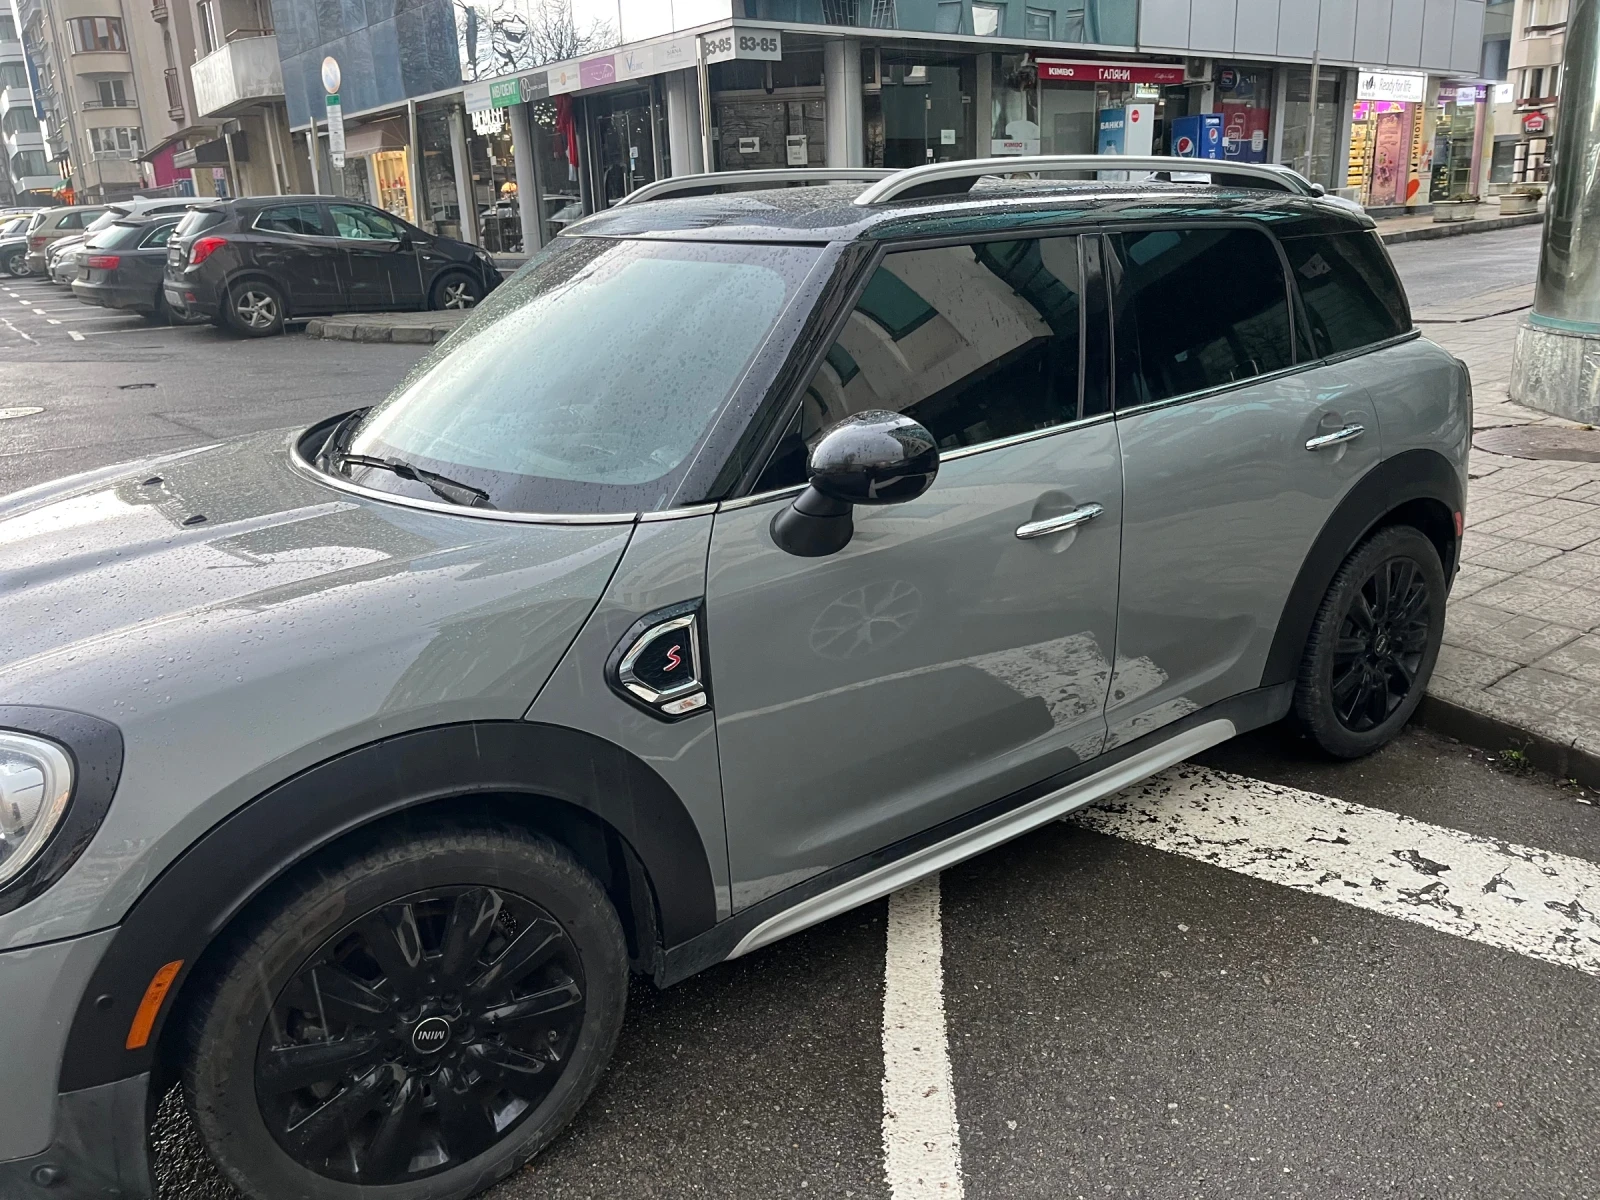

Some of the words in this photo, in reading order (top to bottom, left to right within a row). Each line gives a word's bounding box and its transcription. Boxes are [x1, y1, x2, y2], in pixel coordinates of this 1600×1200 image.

[740, 36, 778, 52] 83-85
[1048, 67, 1074, 77] KIMBO
[1379, 78, 1394, 94] Ready
[1100, 120, 1124, 130] БАНКЯ
[1412, 104, 1423, 160] MYPROTEIN
[663, 644, 681, 672] S
[418, 1030, 445, 1040] MINI
